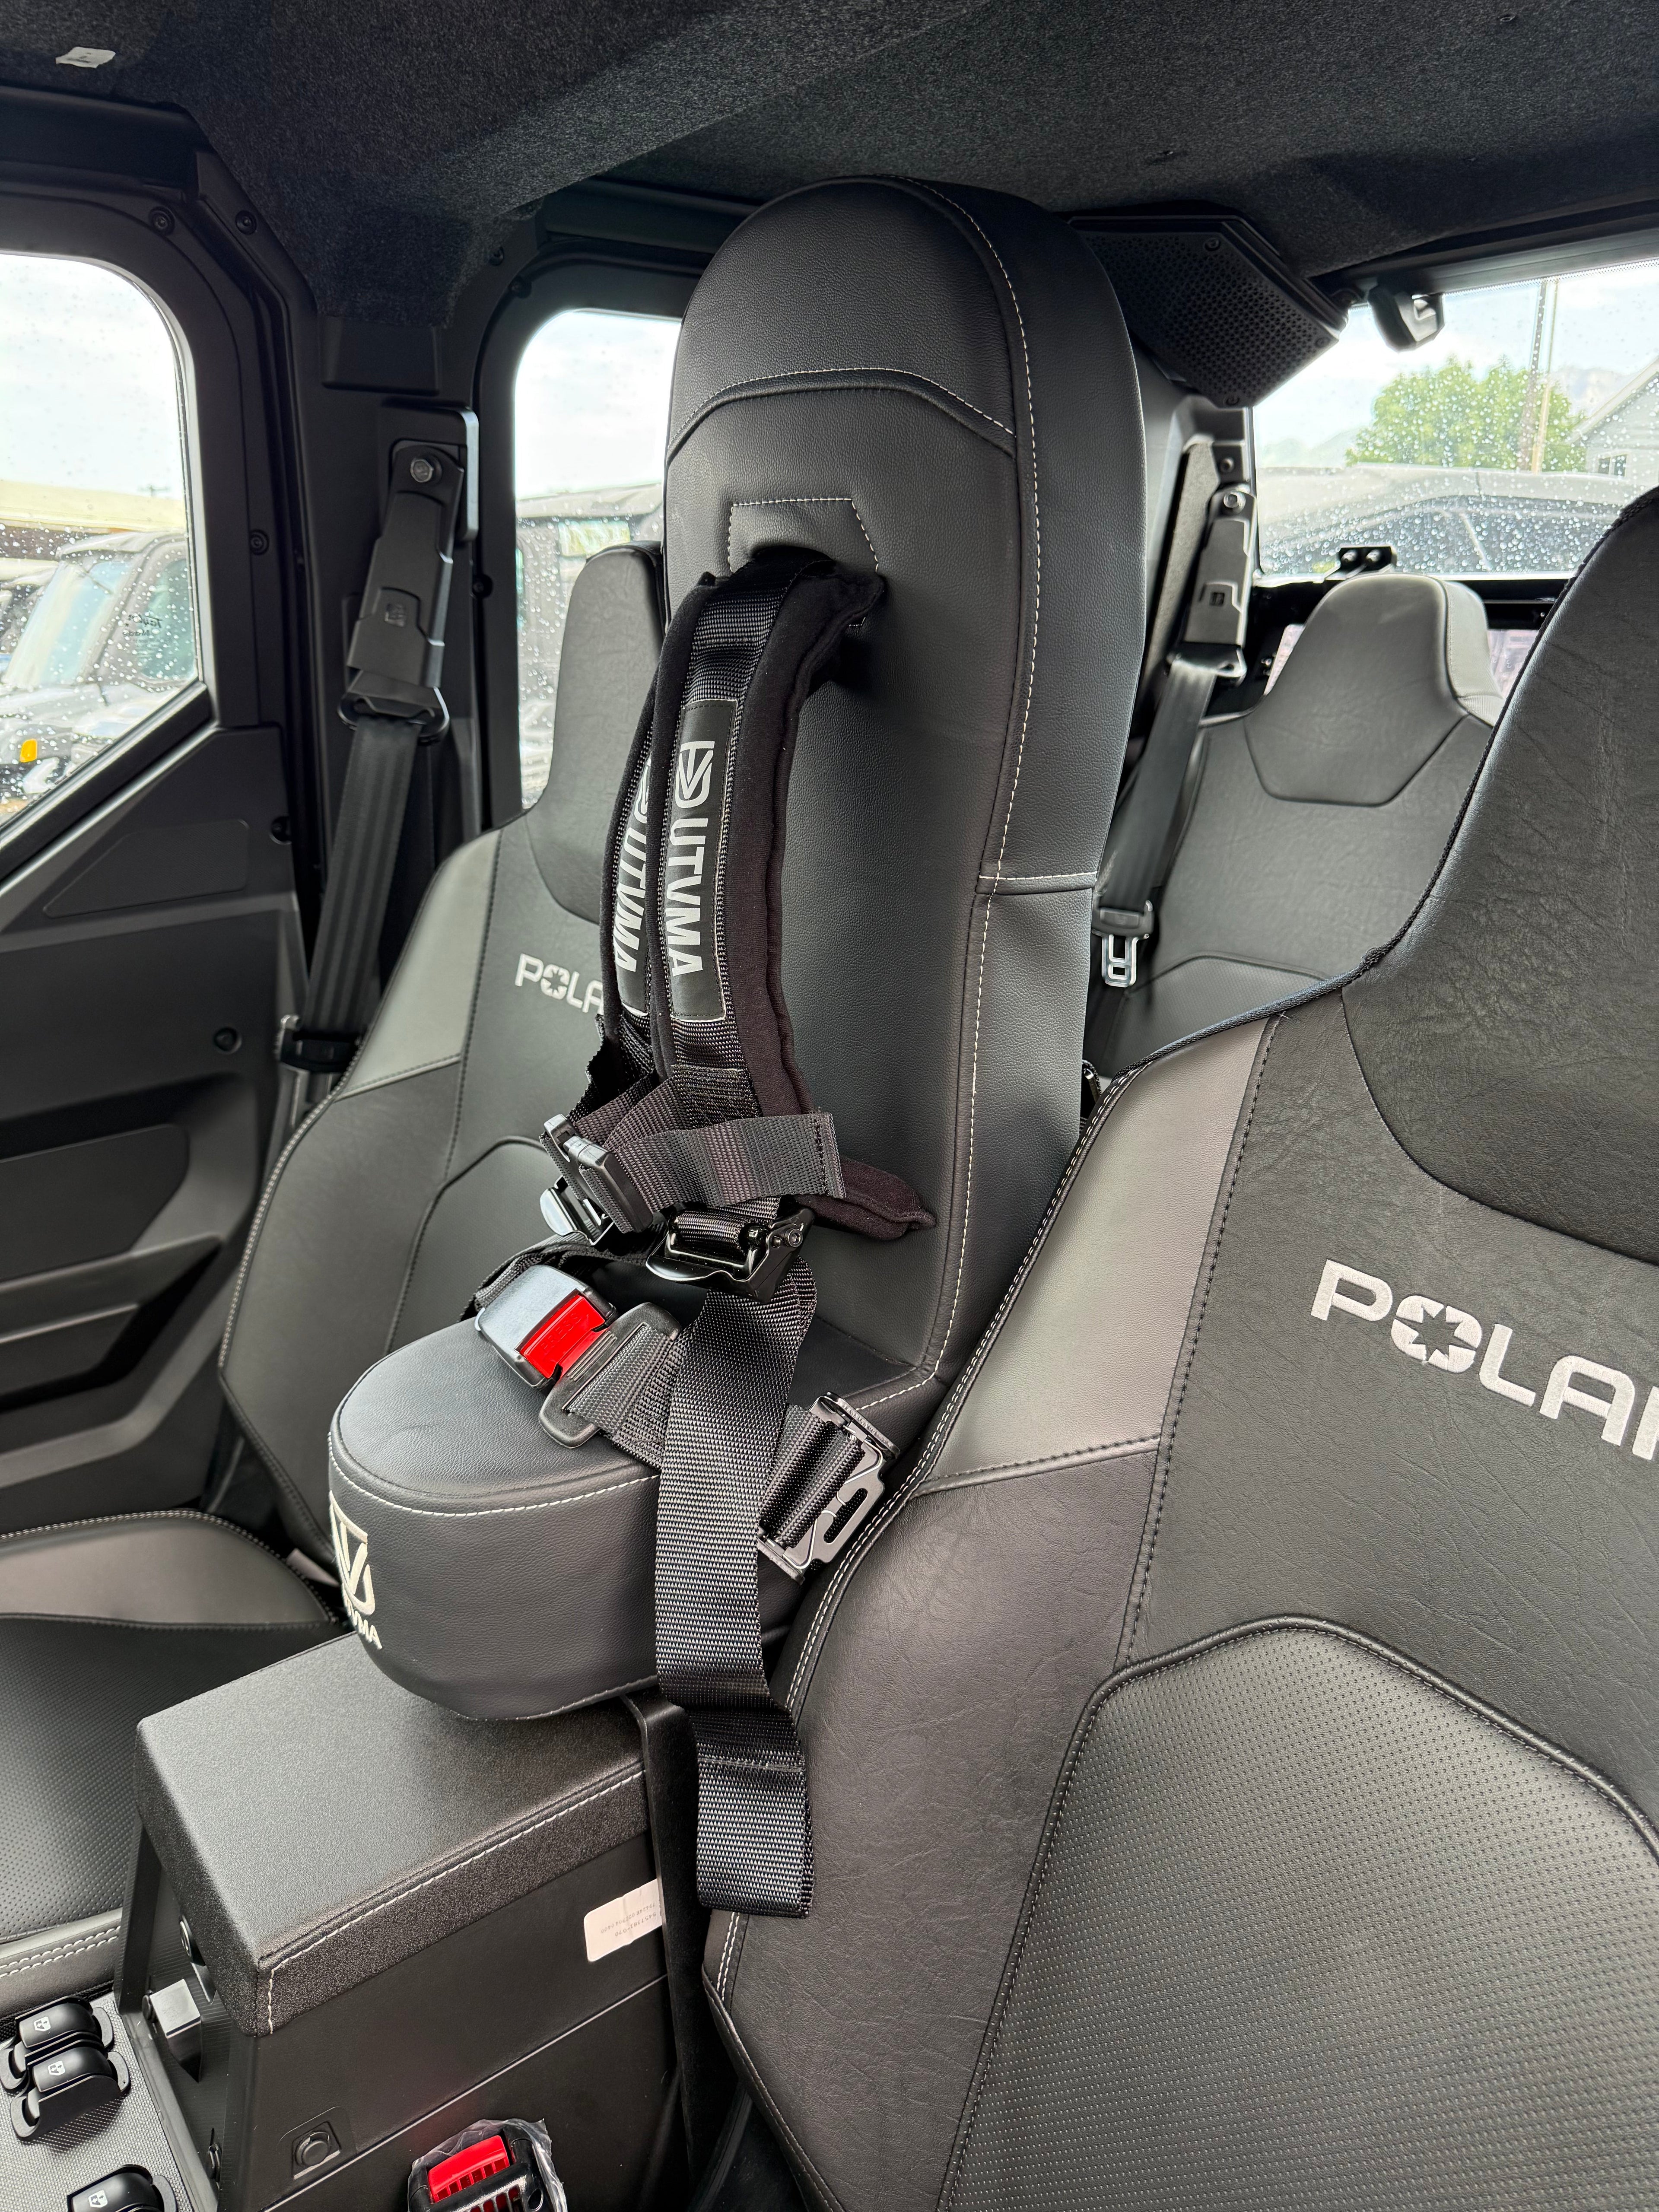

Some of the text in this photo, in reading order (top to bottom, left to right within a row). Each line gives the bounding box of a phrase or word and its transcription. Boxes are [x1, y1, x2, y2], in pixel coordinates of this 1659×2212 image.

[613, 827, 647, 972] UTVMA
[664, 818, 709, 977] UTVMA
[540, 1313, 582, 1354] PRESS
